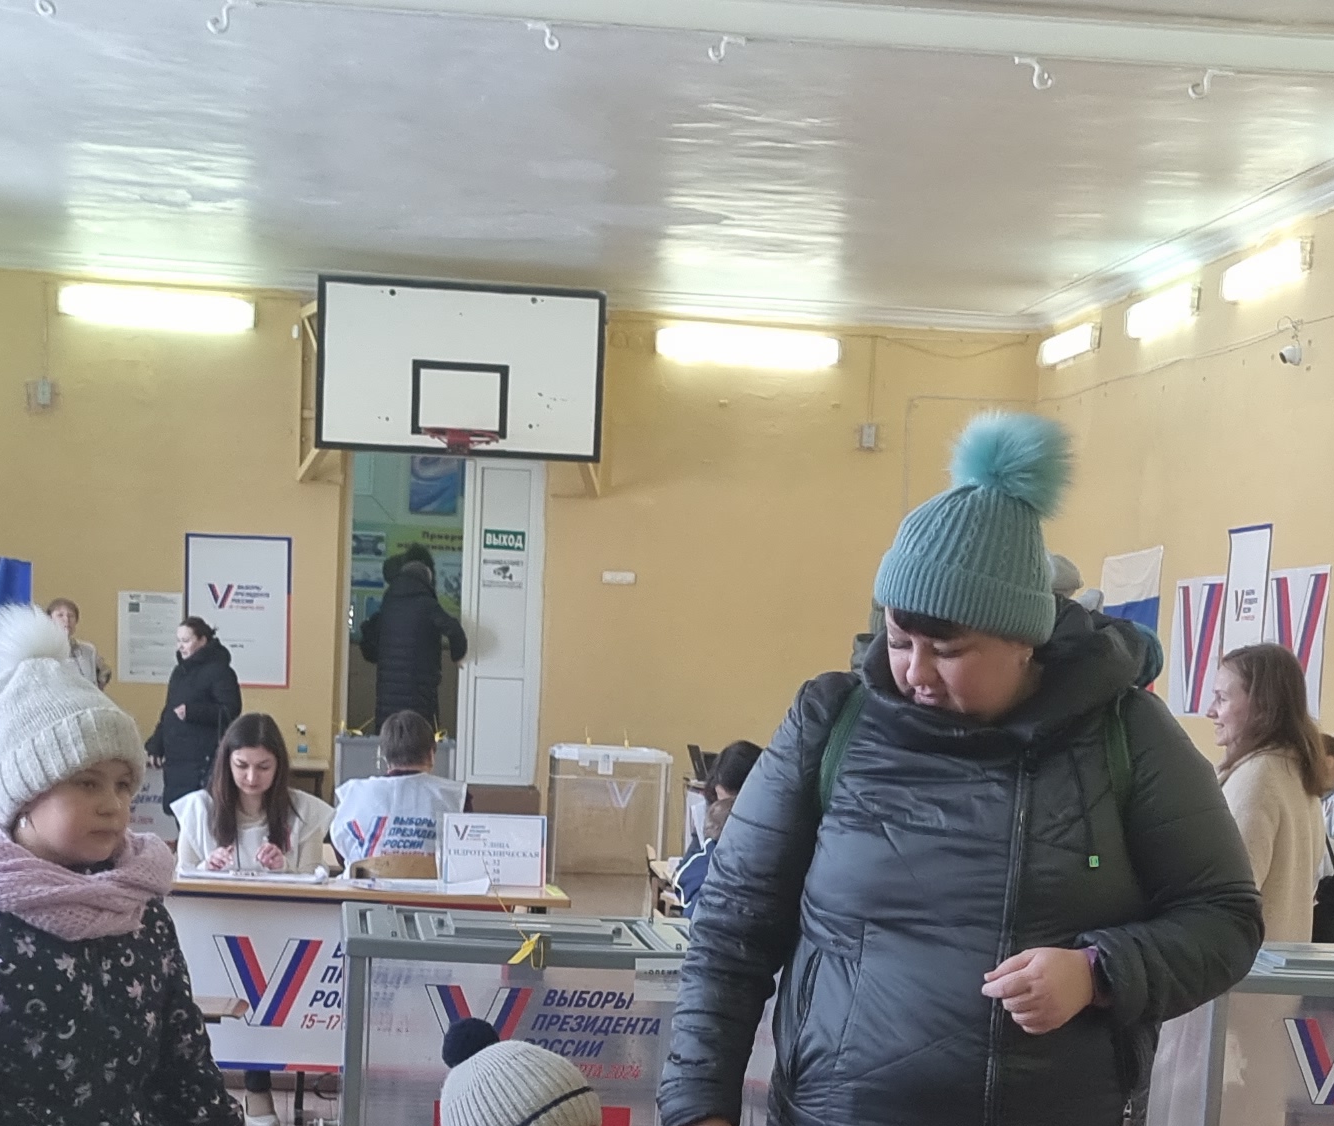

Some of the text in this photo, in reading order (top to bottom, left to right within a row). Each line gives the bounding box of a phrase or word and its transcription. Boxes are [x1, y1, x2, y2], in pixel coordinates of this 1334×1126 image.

[485, 532, 524, 549] ВЫХОД
[393, 816, 436, 828] ВЫБОРЫ
[382, 839, 424, 849] РОССИИ
[542, 989, 634, 1010] ВЫБОРЫ
[531, 1013, 662, 1036] ПРЕЗИДЕНТА
